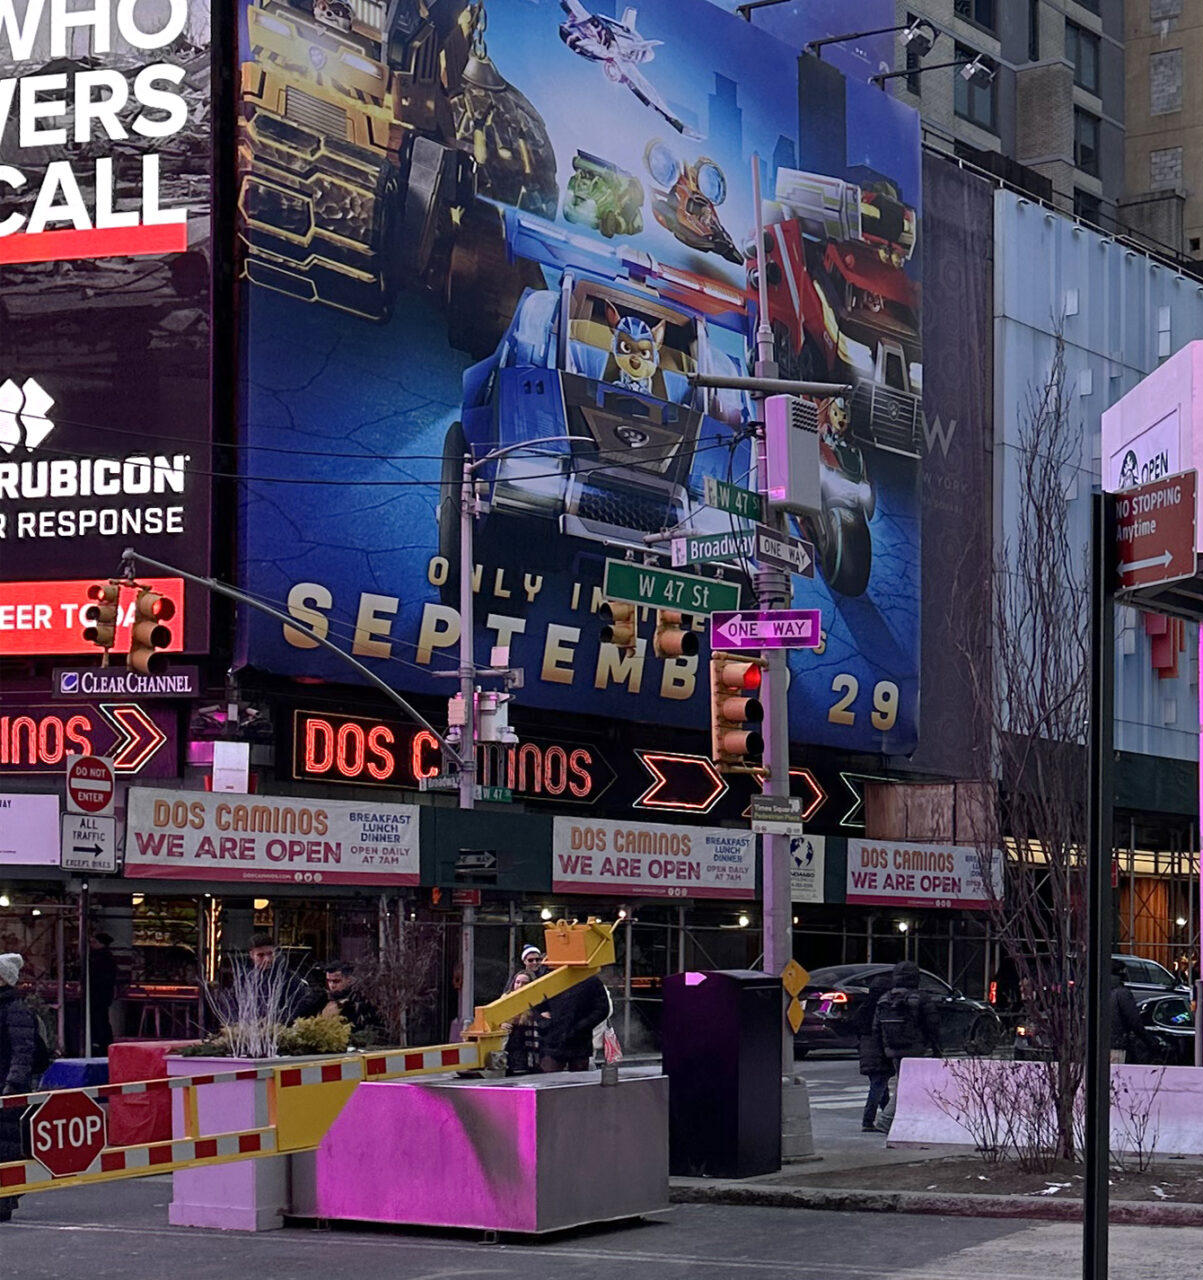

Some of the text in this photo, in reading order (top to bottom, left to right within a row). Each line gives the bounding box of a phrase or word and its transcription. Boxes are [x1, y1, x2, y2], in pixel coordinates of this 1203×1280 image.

[1141, 450, 1168, 484] OPEN
[719, 485, 731, 508] W
[735, 492, 748, 515] 47
[1116, 485, 1181, 518] NO STOPPING
[18, 506, 183, 538] RESPONSE
[1116, 519, 1156, 543] Anytime
[691, 533, 755, 560] Broadway
[764, 538, 806, 565] ONE WAY
[638, 574, 709, 608] W 47 St
[728, 622, 806, 637] ONE WAY
[283, 582, 705, 701] SEPTEMB
[828, 672, 900, 731] 29
[306, 718, 395, 780] DOS
[76, 766, 106, 778] DO NOT
[78, 792, 104, 803] ENTER
[80, 818, 98, 829] ALL
[154, 799, 328, 836] DOS CAMINOS
[350, 812, 411, 824] BREAKFAST
[363, 823, 398, 833] LUNCH
[73, 830, 105, 841] TRAFFIC
[135, 832, 342, 864] WE ARE OPEN
[360, 832, 401, 843] DINNER
[571, 826, 691, 856] DOS CAMINOS
[706, 837, 750, 847] BREAKFAST
[350, 846, 410, 857] OPEN DAILY
[362, 855, 399, 865] AT 7AM
[713, 854, 742, 863] DINNER
[715, 846, 741, 854] LUNCH
[861, 847, 888, 869] DOS
[893, 849, 954, 873] CAMINOS
[558, 854, 700, 880] WE ARE OPEN
[851, 871, 961, 893] WE ARE OPEN
[37, 1115, 102, 1152] STOP
